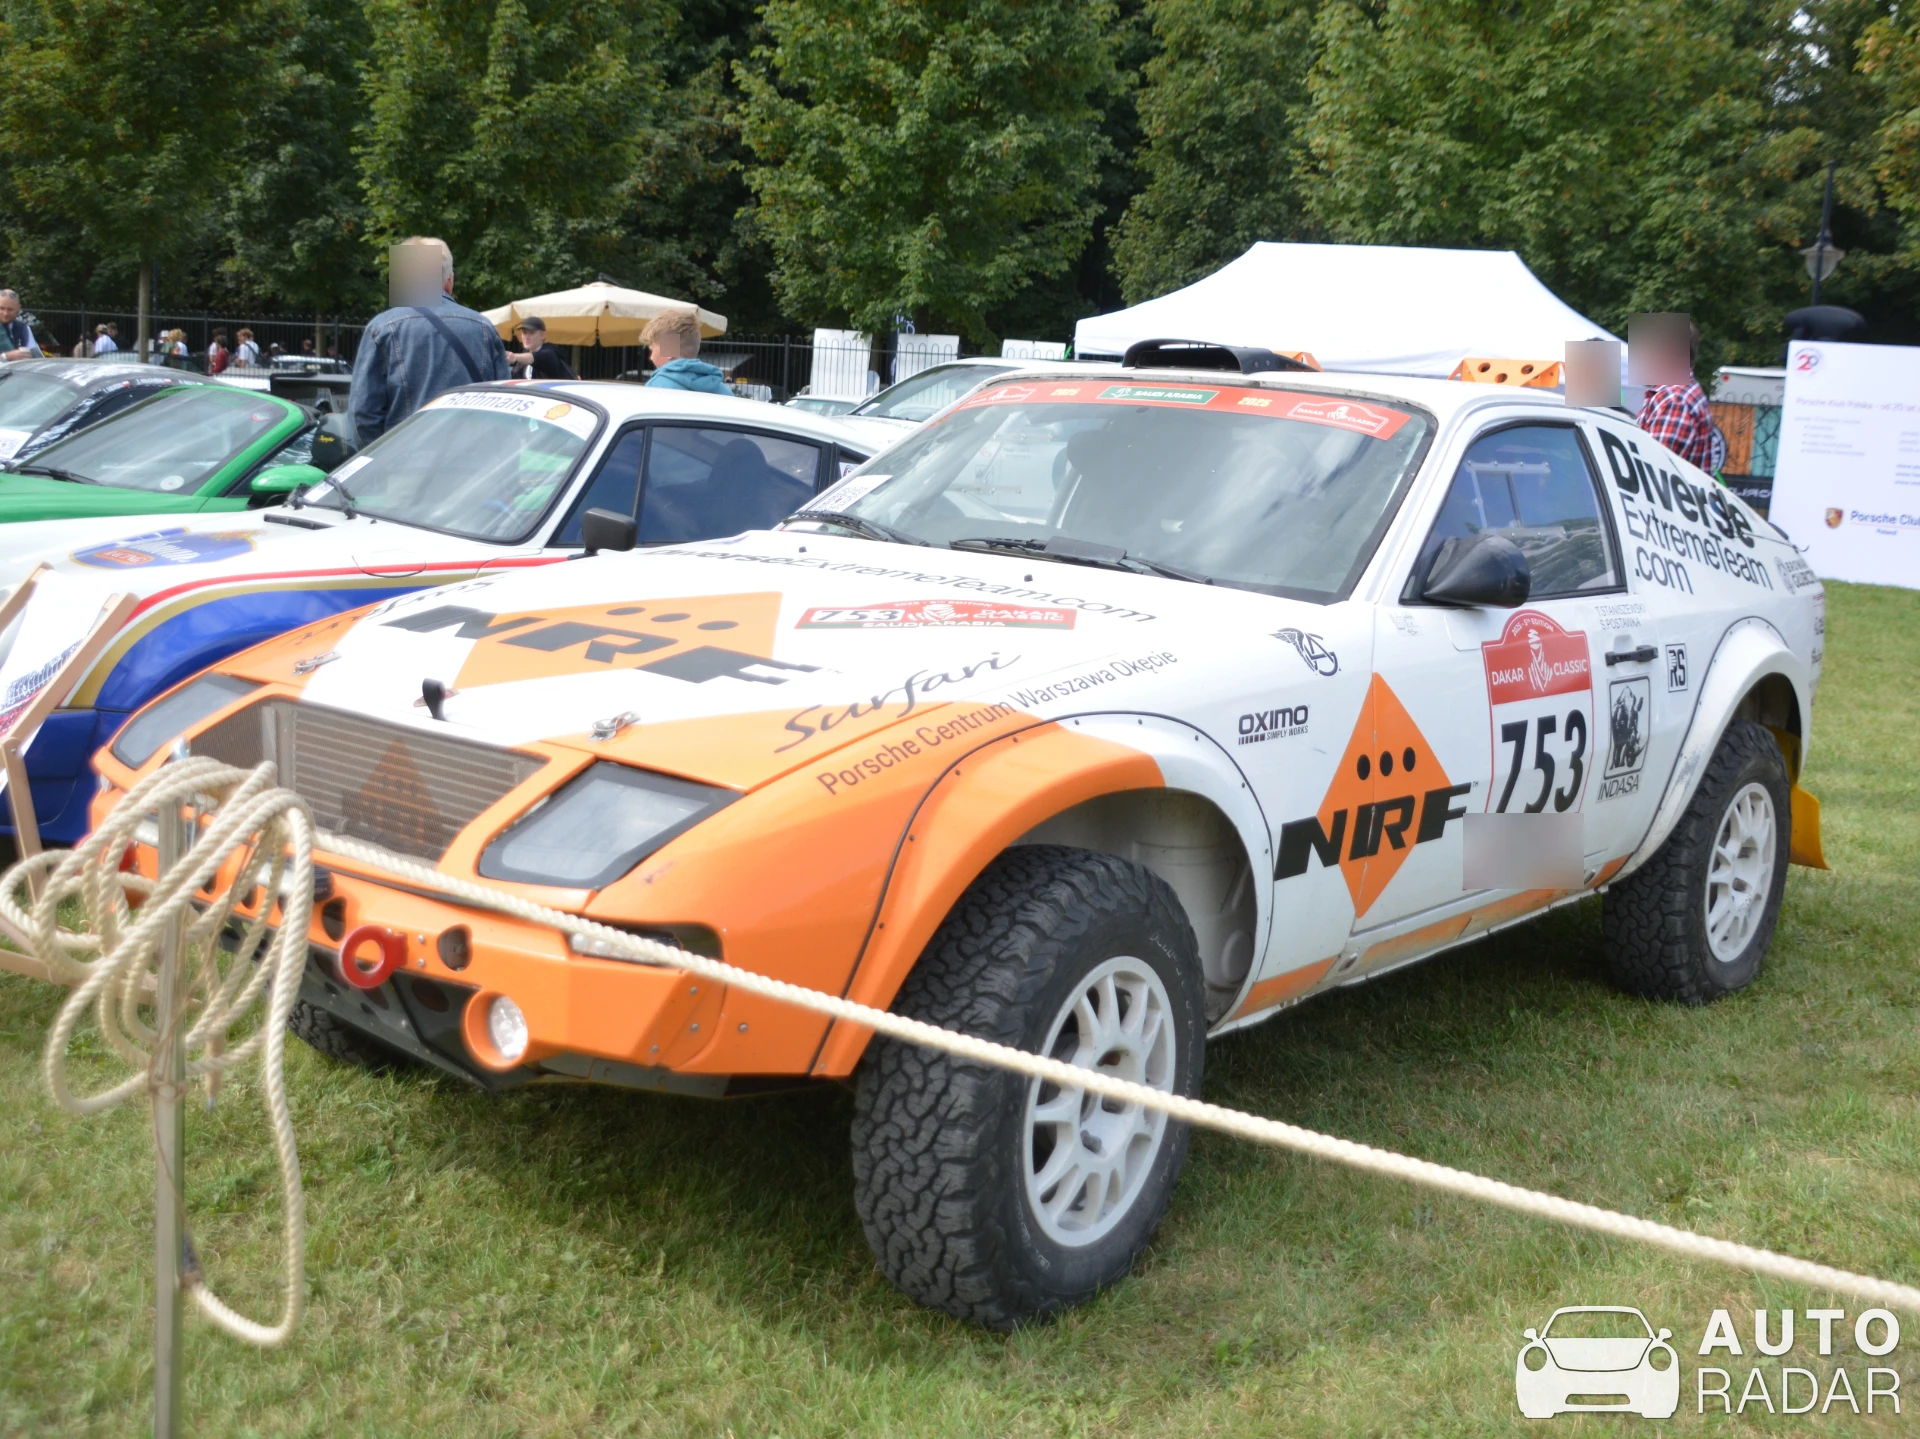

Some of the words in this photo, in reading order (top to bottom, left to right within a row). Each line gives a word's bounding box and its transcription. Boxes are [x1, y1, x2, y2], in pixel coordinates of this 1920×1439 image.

[1132, 389, 1162, 398] SAUDI
[1163, 391, 1203, 400] ARABIA
[1237, 397, 1272, 408] 2025
[1296, 407, 1323, 416] DAKAR
[1347, 416, 1379, 427] CLASSIC
[1596, 426, 1756, 549] Diverse
[1850, 510, 1898, 524] Porsche
[1618, 491, 1774, 591] ExtremeTeam
[1635, 546, 1694, 595] .com
[814, 610, 900, 622] 753
[926, 619, 1006, 627] ARABIA
[377, 604, 823, 686] NRF
[1491, 667, 1525, 687] DAKAR
[1553, 659, 1588, 676] CLASSIC
[775, 652, 1022, 753] Surfari
[816, 738, 922, 795] Porsche
[916, 701, 1018, 749] Centrum
[1011, 670, 1116, 709] Warszawa
[1119, 648, 1178, 678] Okęcie
[1238, 704, 1309, 735] OXIMO
[1266, 728, 1287, 741] SIMPLY
[1288, 725, 1309, 738] WORKS
[1496, 709, 1588, 813] 753
[1598, 773, 1640, 799] INDASA
[1274, 782, 1472, 881] NRF
